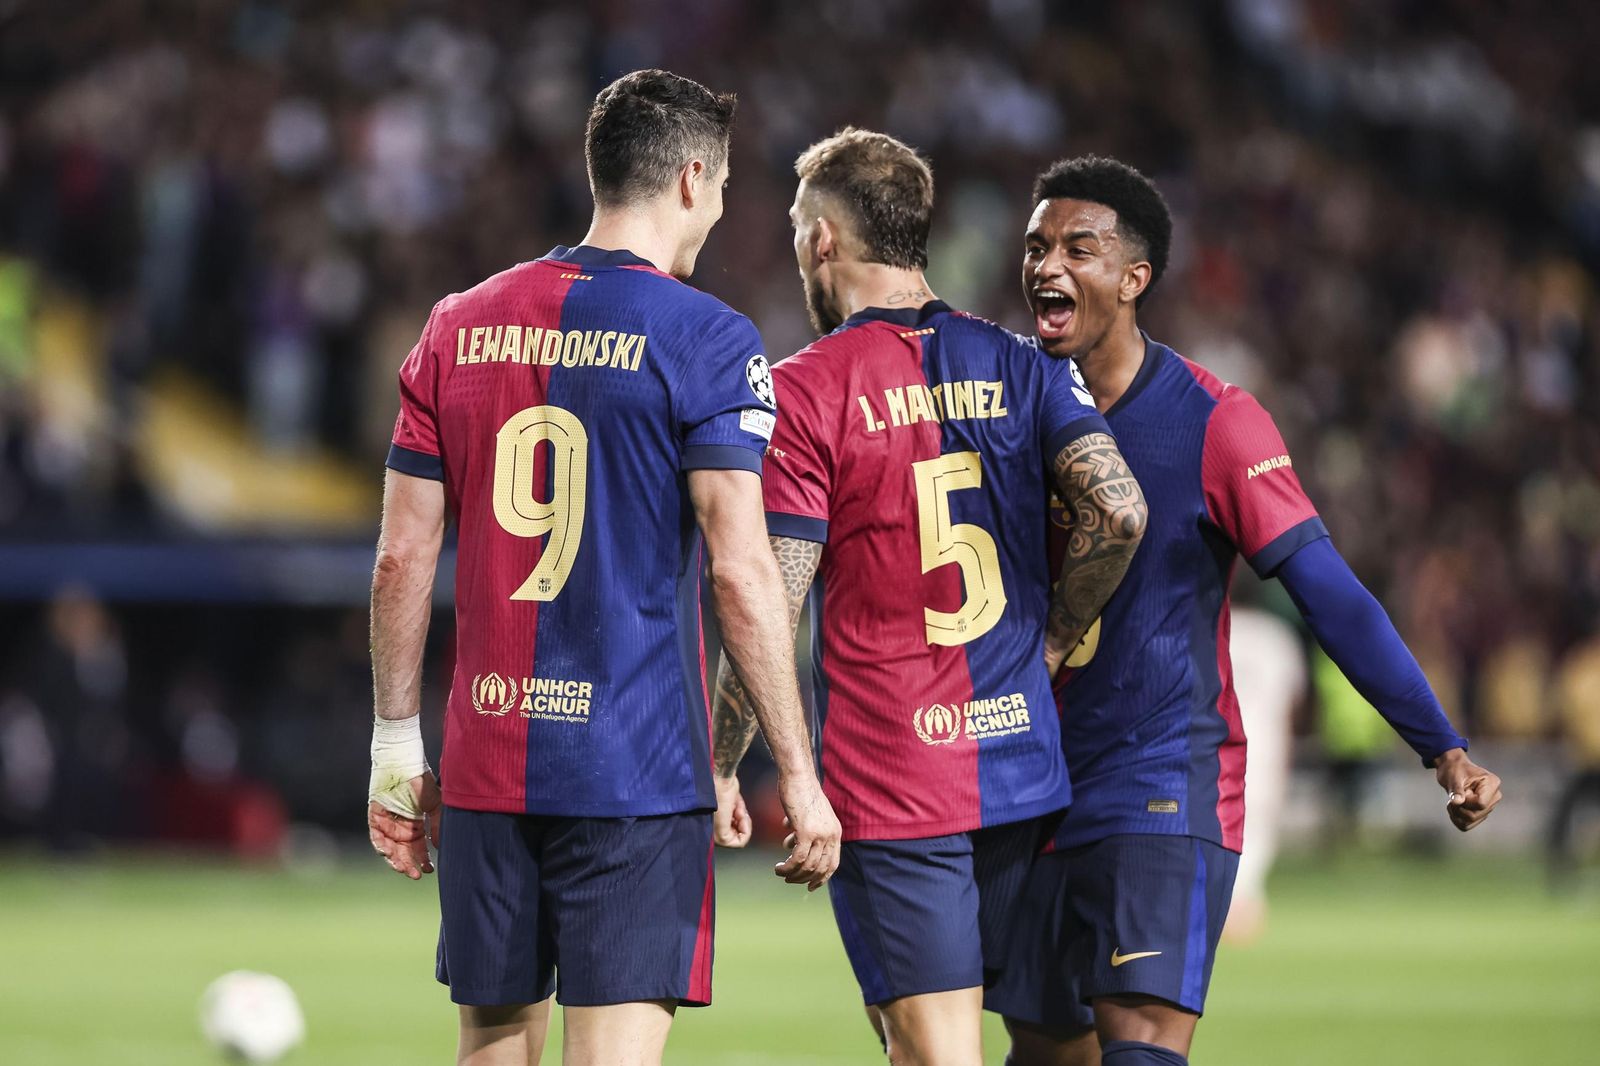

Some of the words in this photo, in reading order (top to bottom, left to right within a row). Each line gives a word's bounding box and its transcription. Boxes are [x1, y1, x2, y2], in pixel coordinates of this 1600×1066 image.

[456, 325, 647, 371] LEWANDOWSKI
[492, 405, 589, 602] 9
[911, 451, 1008, 647] 5
[522, 677, 593, 698] UNHCR
[519, 694, 591, 715] ACNUR
[963, 692, 1027, 717] UNHCR
[541, 713, 565, 722] Refugee
[565, 715, 589, 724] Agency
[964, 708, 1031, 734] ACNUR
